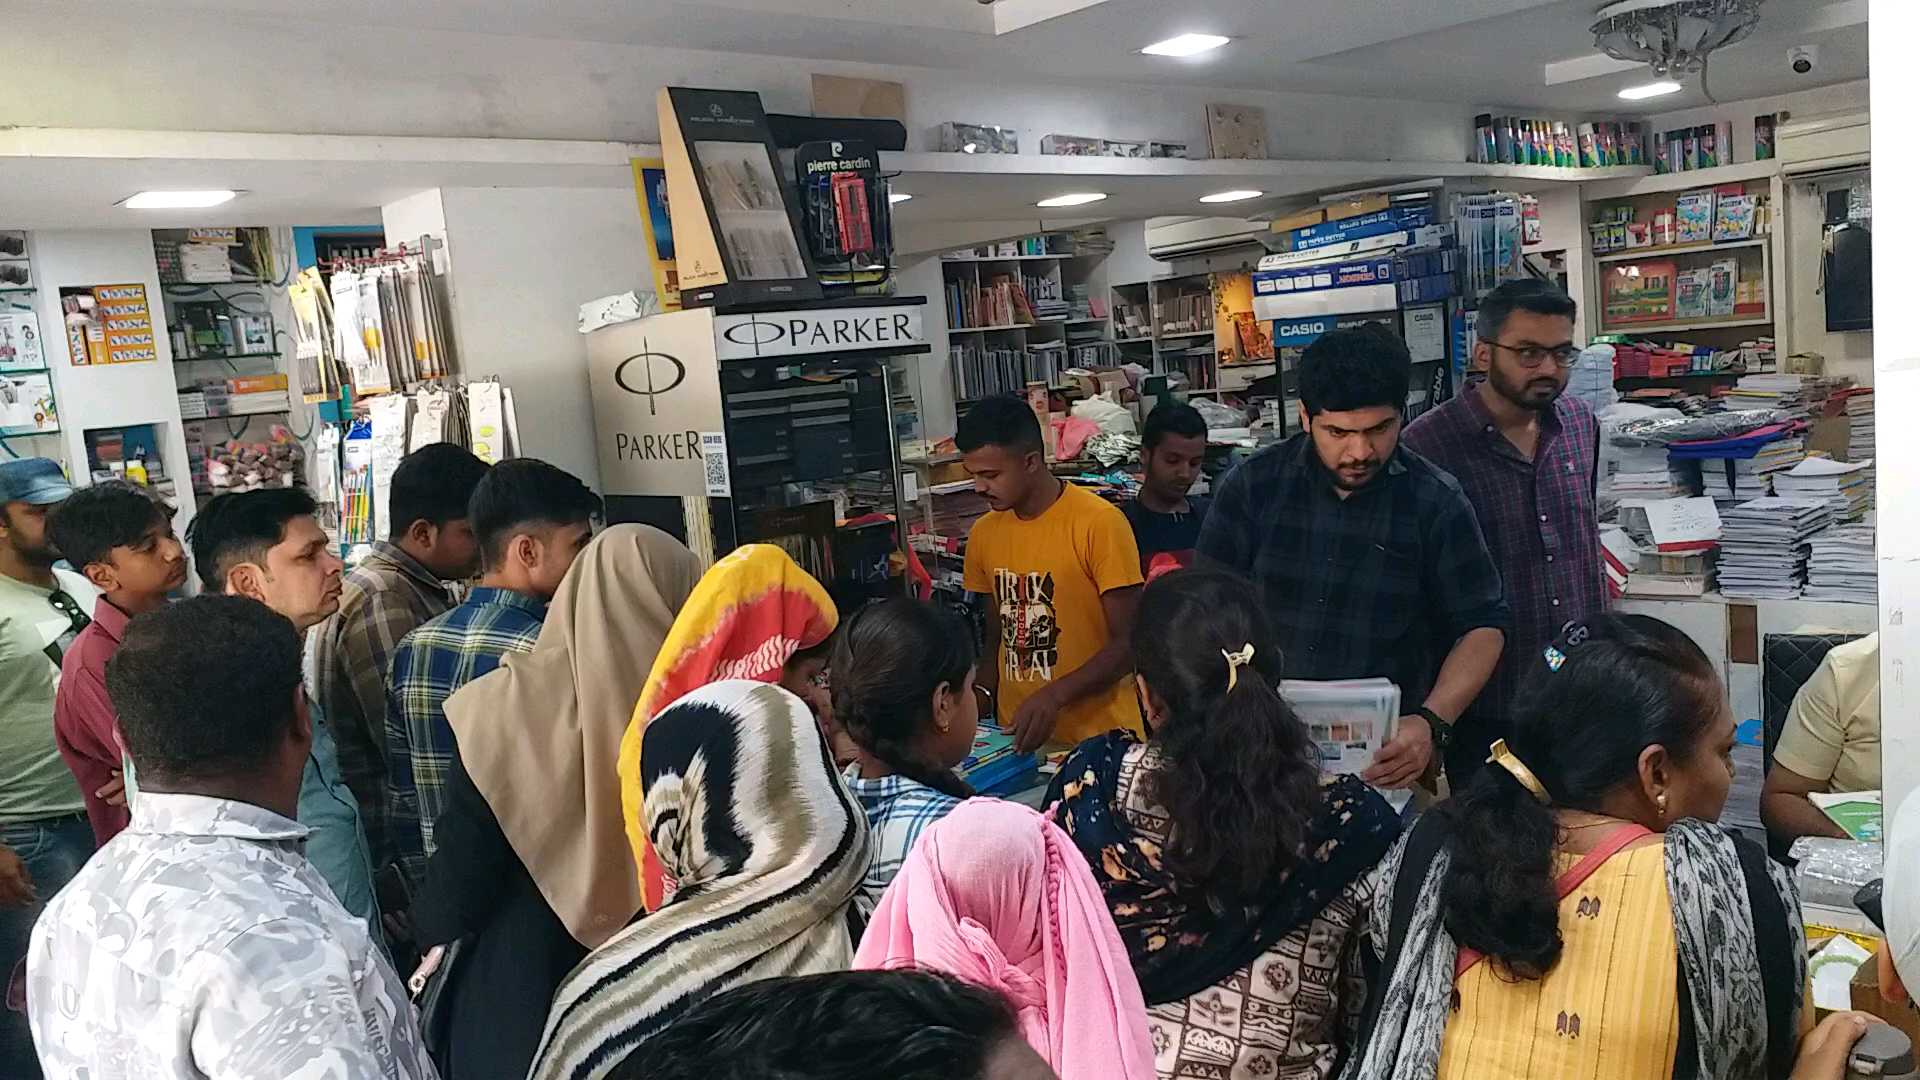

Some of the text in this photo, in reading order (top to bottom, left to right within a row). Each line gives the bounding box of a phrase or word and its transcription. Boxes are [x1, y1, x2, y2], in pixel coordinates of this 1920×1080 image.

[807, 157, 872, 175] pierre cardin
[789, 314, 912, 346] PARKER
[1280, 322, 1325, 337] CASIO
[616, 430, 703, 461] PARKER
